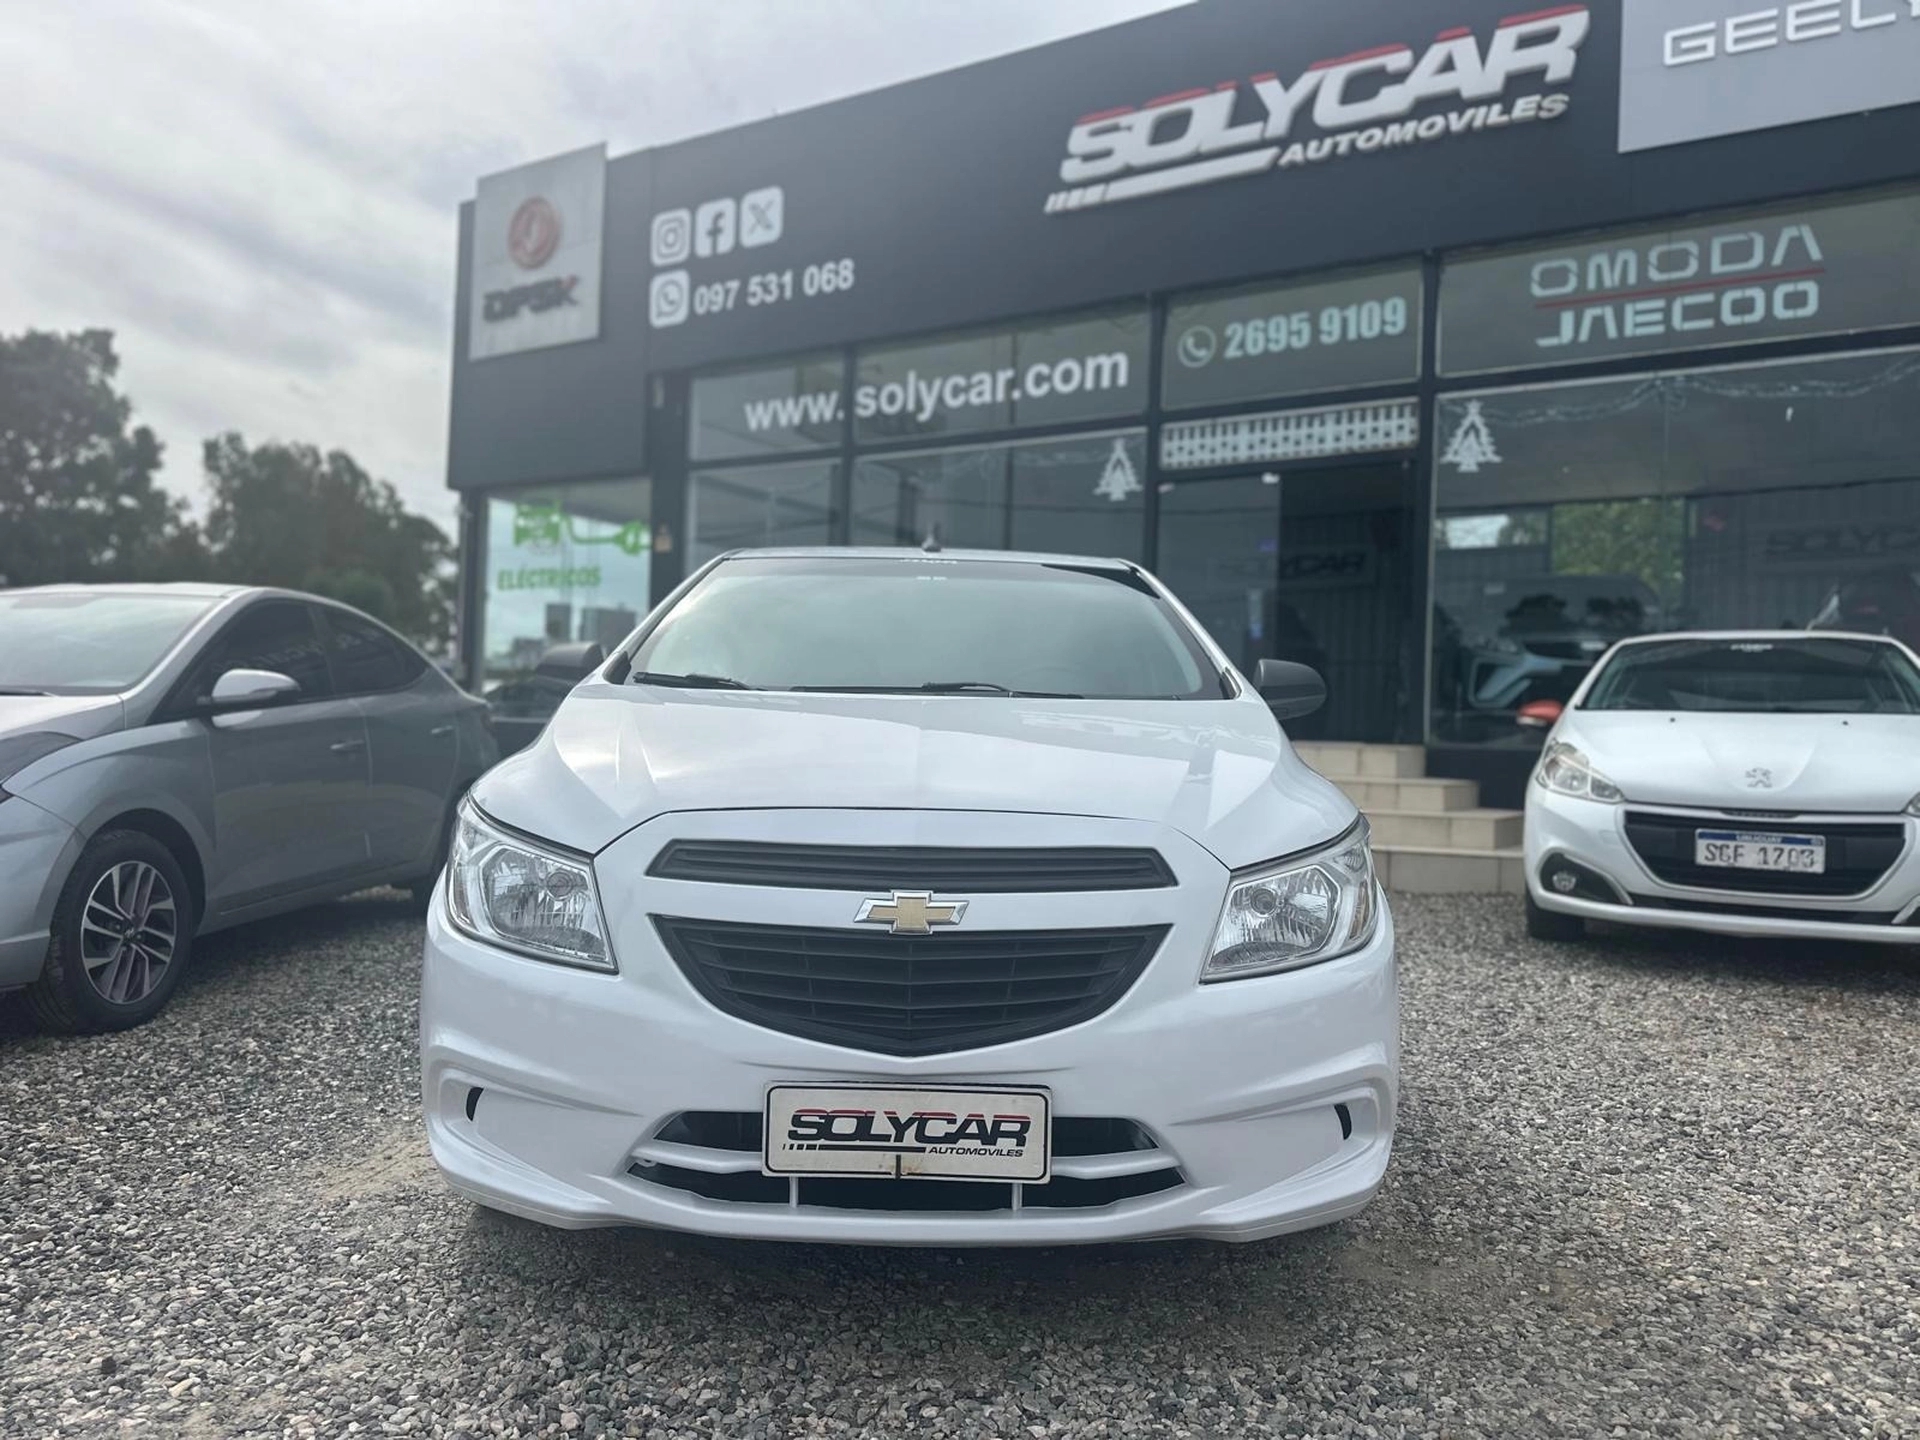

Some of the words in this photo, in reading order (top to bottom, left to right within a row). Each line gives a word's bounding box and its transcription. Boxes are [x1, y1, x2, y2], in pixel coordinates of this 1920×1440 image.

[1060, 4, 1591, 184] SOLYCAR
[1278, 93, 1570, 168] AUTOMOVILES
[694, 281, 740, 316] 097
[747, 270, 794, 307] 531
[803, 258, 856, 298] 068
[1530, 224, 1824, 298] OMODA
[1223, 318, 1311, 360] 2695
[1319, 297, 1408, 346] 9109
[1535, 280, 1820, 347] JAECOO
[787, 1108, 1032, 1147] SOLYCAR
[928, 1146, 1024, 1158] AUTOMOVILES
